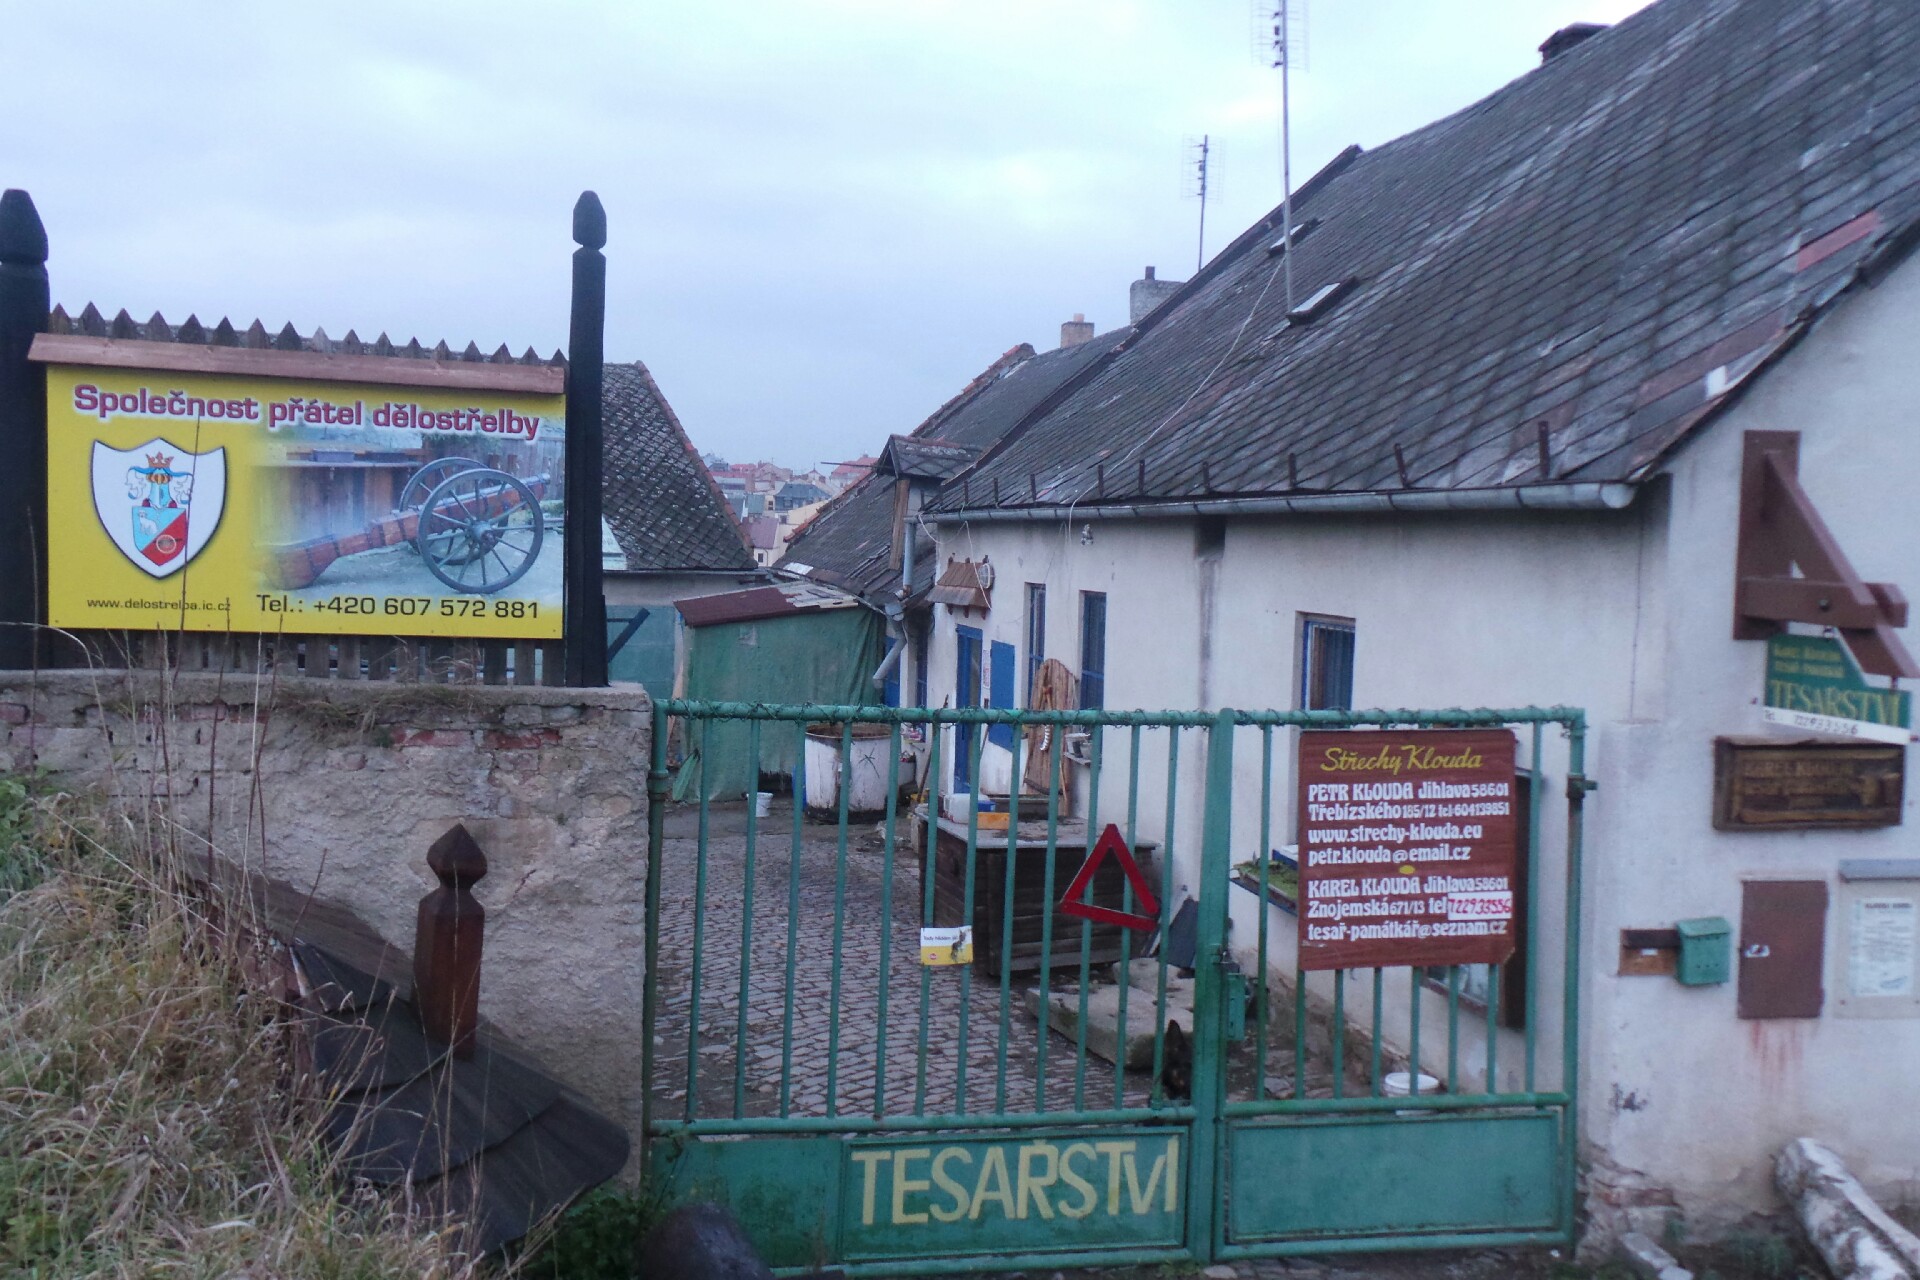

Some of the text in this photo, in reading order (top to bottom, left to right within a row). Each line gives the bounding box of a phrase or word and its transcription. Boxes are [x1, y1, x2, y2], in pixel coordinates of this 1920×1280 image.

[74, 384, 540, 441] Společnost přátel dělostřelby
[256, 594, 538, 619] Tel.: +420 607 572 881
[1320, 744, 1483, 776] Střechy Klouda
[1308, 783, 1349, 802] PETR
[1352, 782, 1414, 800] KLOUDA
[1308, 822, 1483, 844] www.strechy-klouda.eu
[1308, 879, 1359, 899] KAREL
[1362, 876, 1421, 896] KLOUDA
